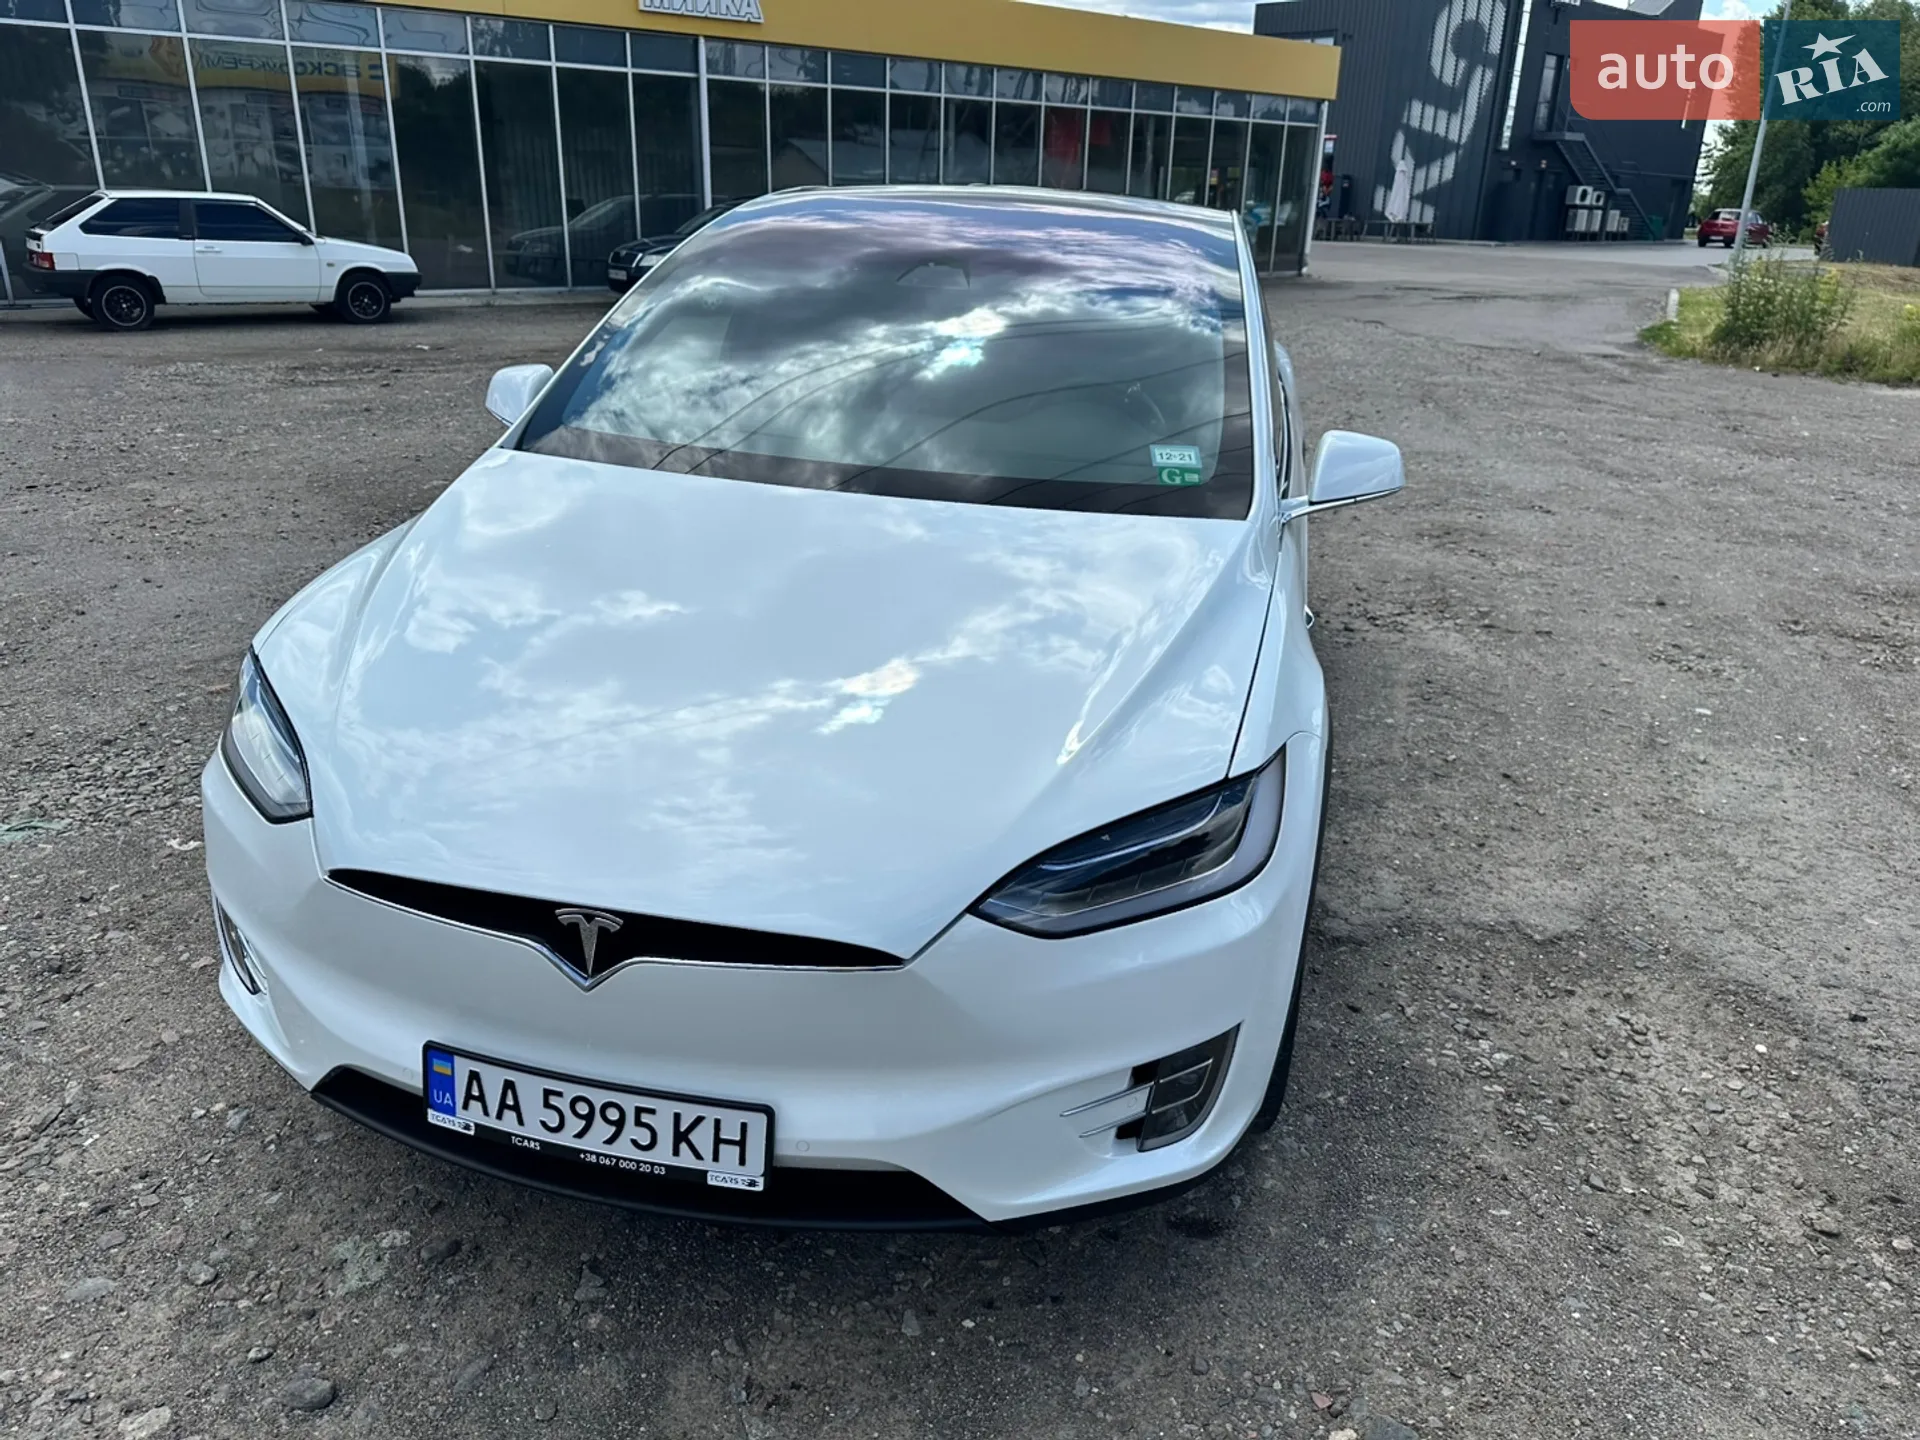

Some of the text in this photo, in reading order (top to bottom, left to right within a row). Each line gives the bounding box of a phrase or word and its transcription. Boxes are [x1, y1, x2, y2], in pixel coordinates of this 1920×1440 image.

[1161, 468, 1182, 484] G
[433, 1089, 453, 1107] UA
[462, 1069, 748, 1167] AA 5995 KH
[511, 1136, 541, 1151] TCARS
[579, 1153, 666, 1175] +38 067 000 20 03
